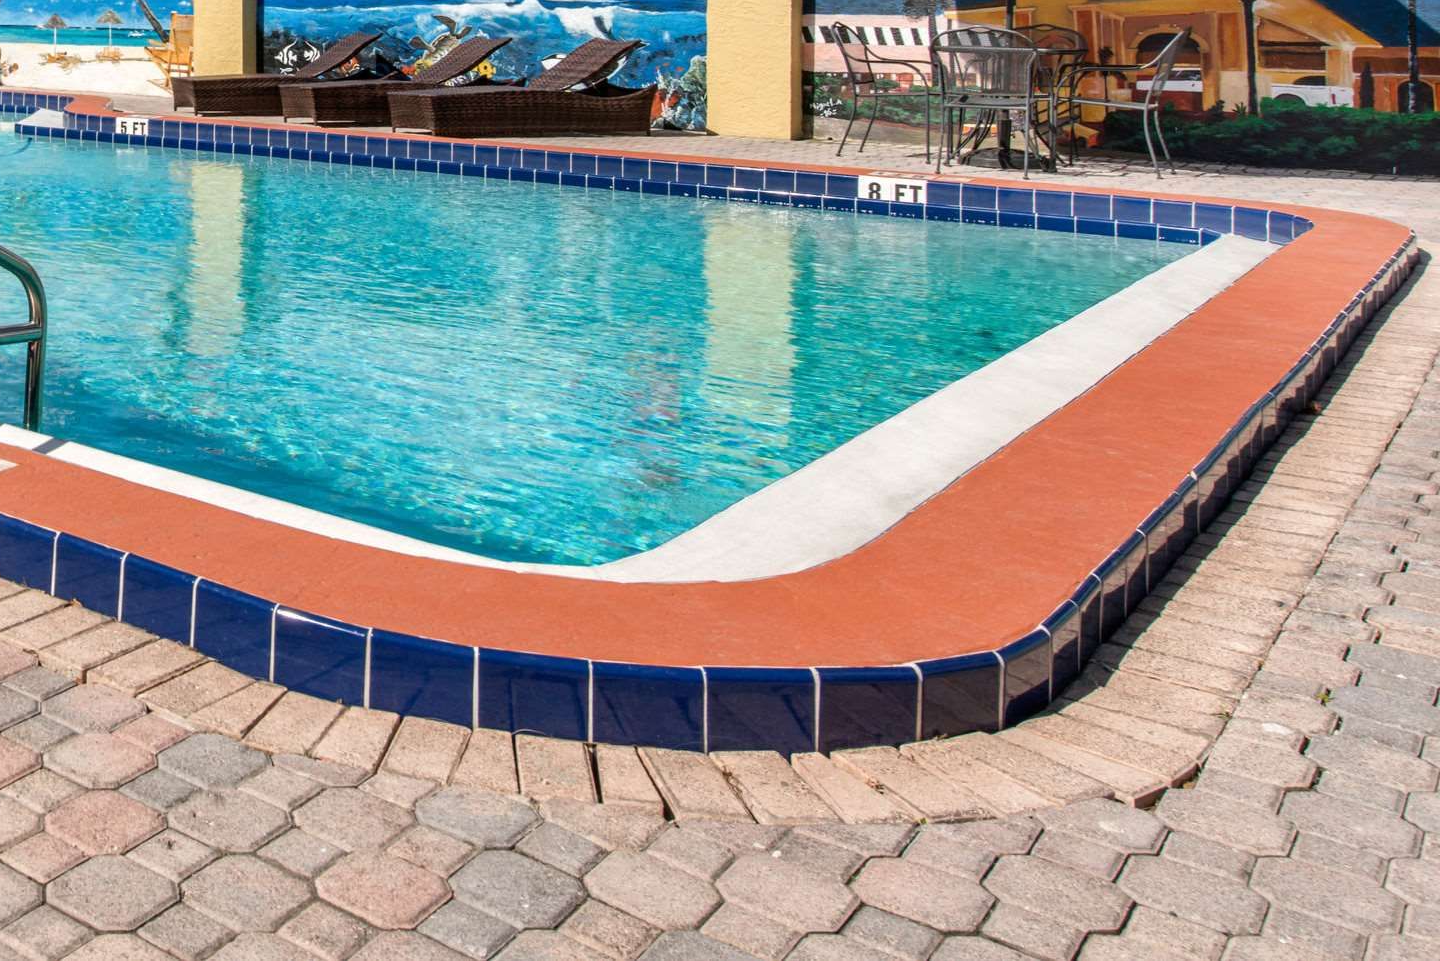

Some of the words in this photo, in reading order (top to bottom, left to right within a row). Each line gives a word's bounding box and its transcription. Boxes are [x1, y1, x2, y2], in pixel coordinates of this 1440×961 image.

[120, 121, 128, 134] 5
[132, 121, 147, 136] FT
[868, 181, 882, 200] 8
[894, 183, 923, 203] FT
